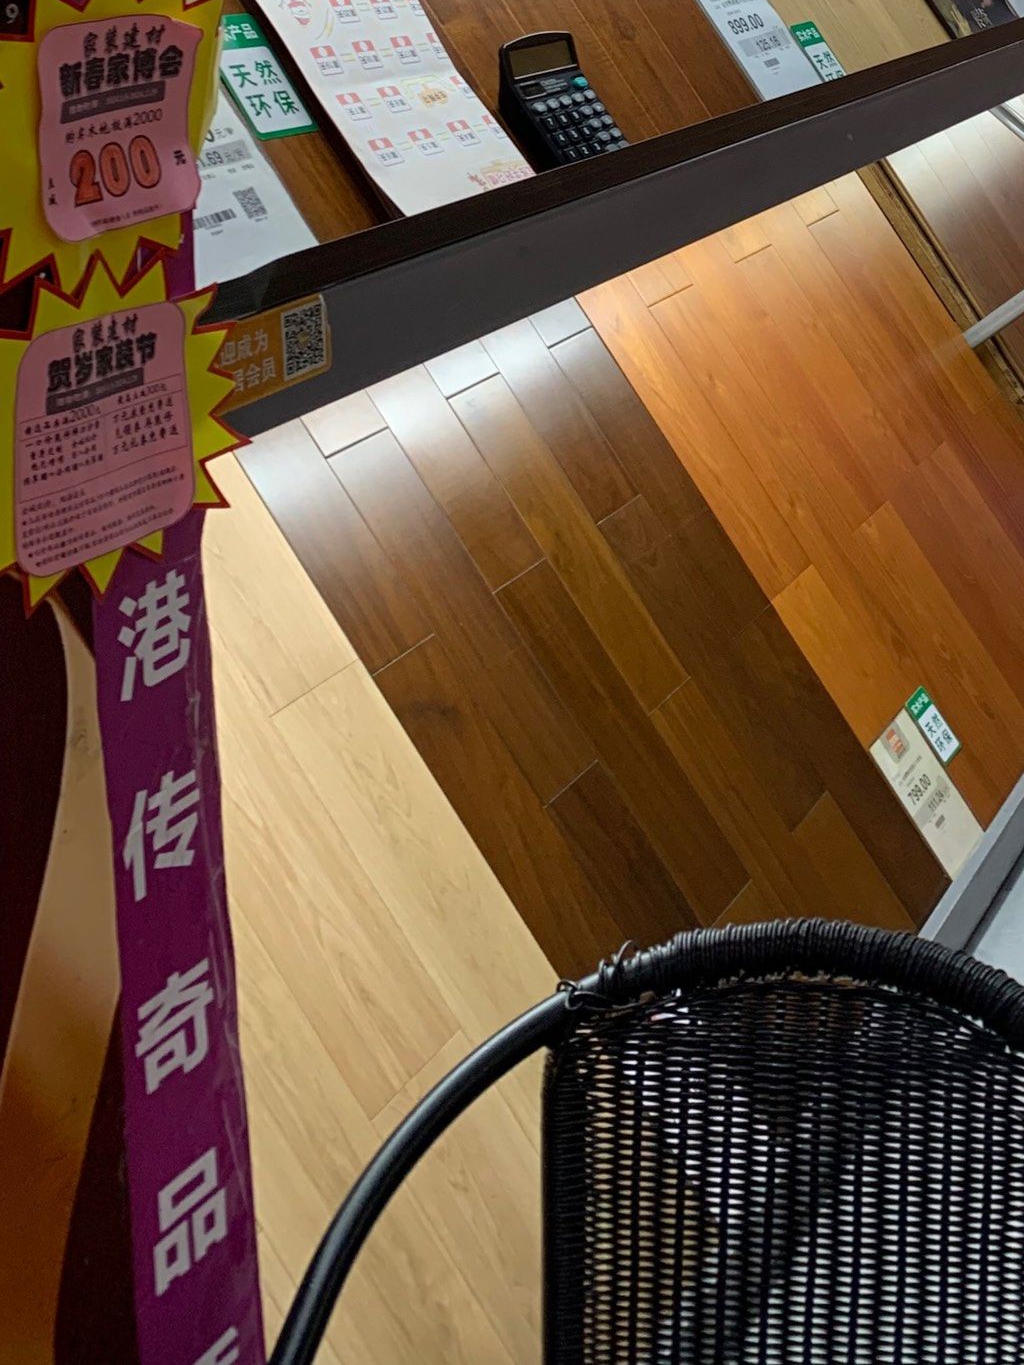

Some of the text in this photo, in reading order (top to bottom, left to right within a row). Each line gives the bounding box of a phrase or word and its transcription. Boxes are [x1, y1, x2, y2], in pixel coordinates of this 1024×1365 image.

[727, 13, 765, 35] 899.00
[59, 44, 184, 98] 新春家博会
[229, 59, 283, 89] 天然
[245, 90, 300, 119] 环保
[69, 134, 162, 208] 200
[47, 331, 158, 392] 贺岁家装节
[907, 773, 932, 806] 799.00
